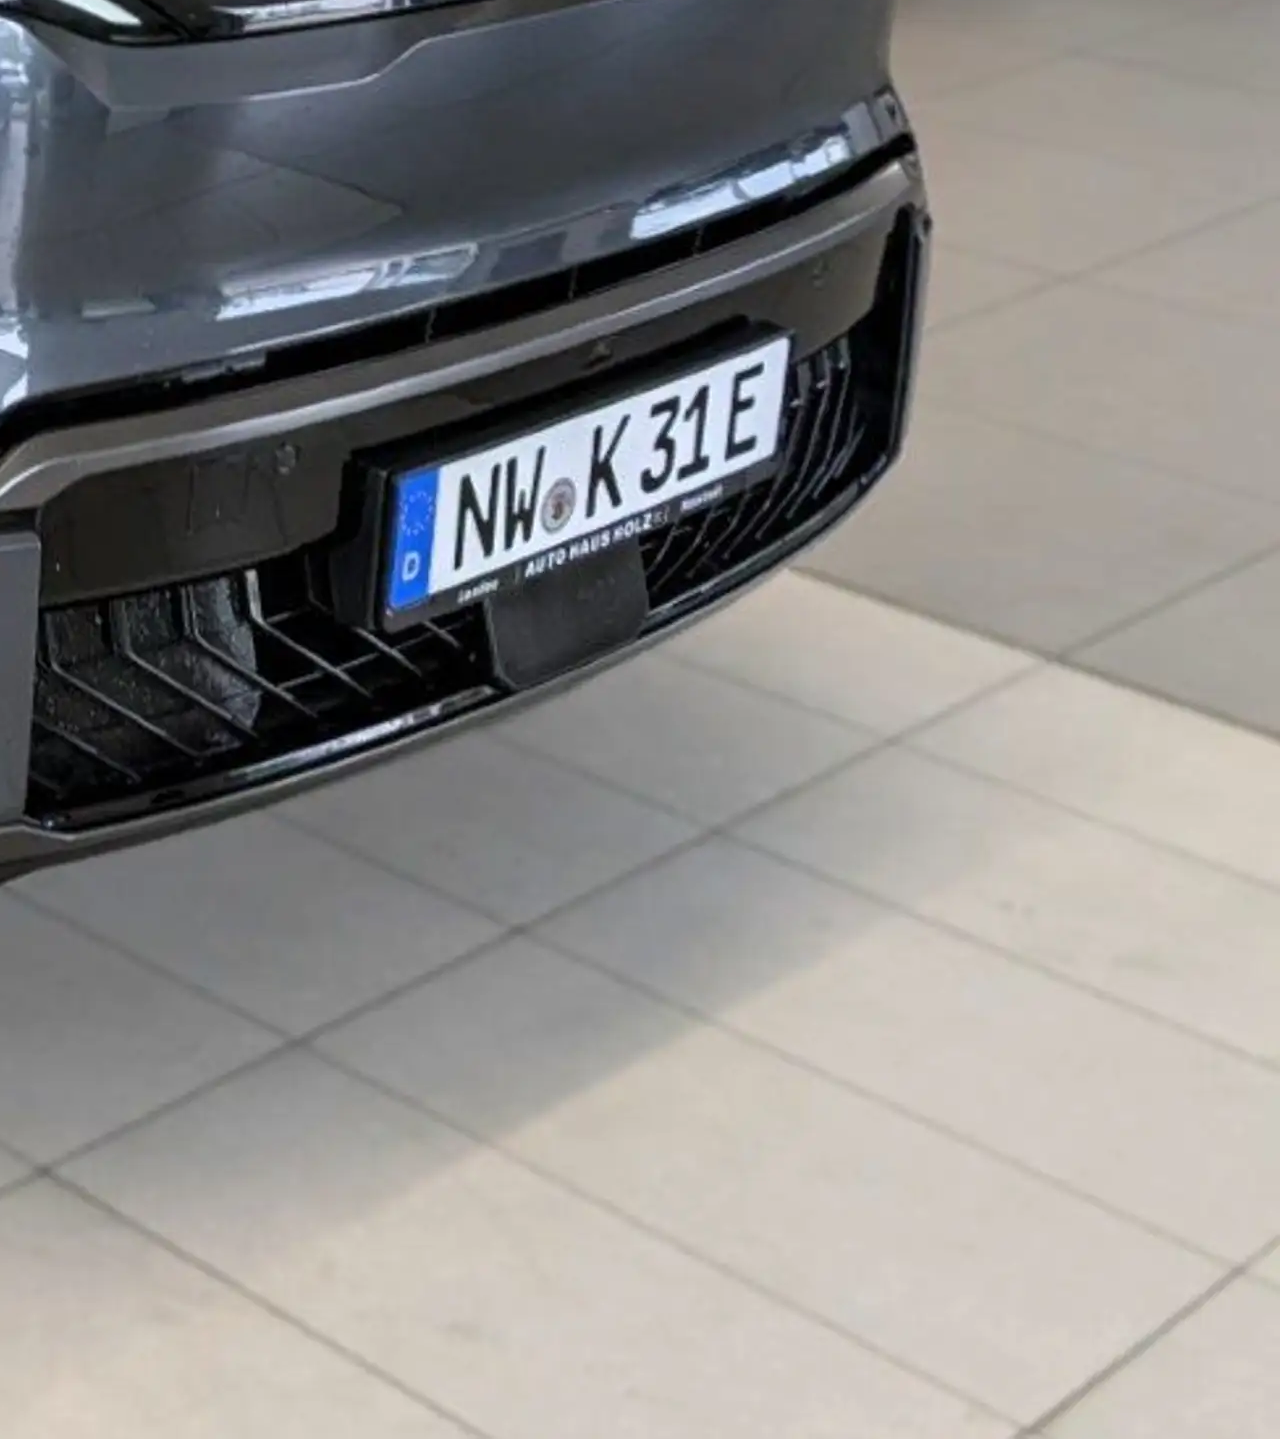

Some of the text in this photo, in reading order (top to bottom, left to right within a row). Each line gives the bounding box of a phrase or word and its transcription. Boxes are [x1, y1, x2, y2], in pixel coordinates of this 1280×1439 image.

[454, 445, 546, 571] NW
[402, 552, 419, 582] D
[525, 550, 566, 578] AUTO
[569, 531, 611, 560] HAUS
